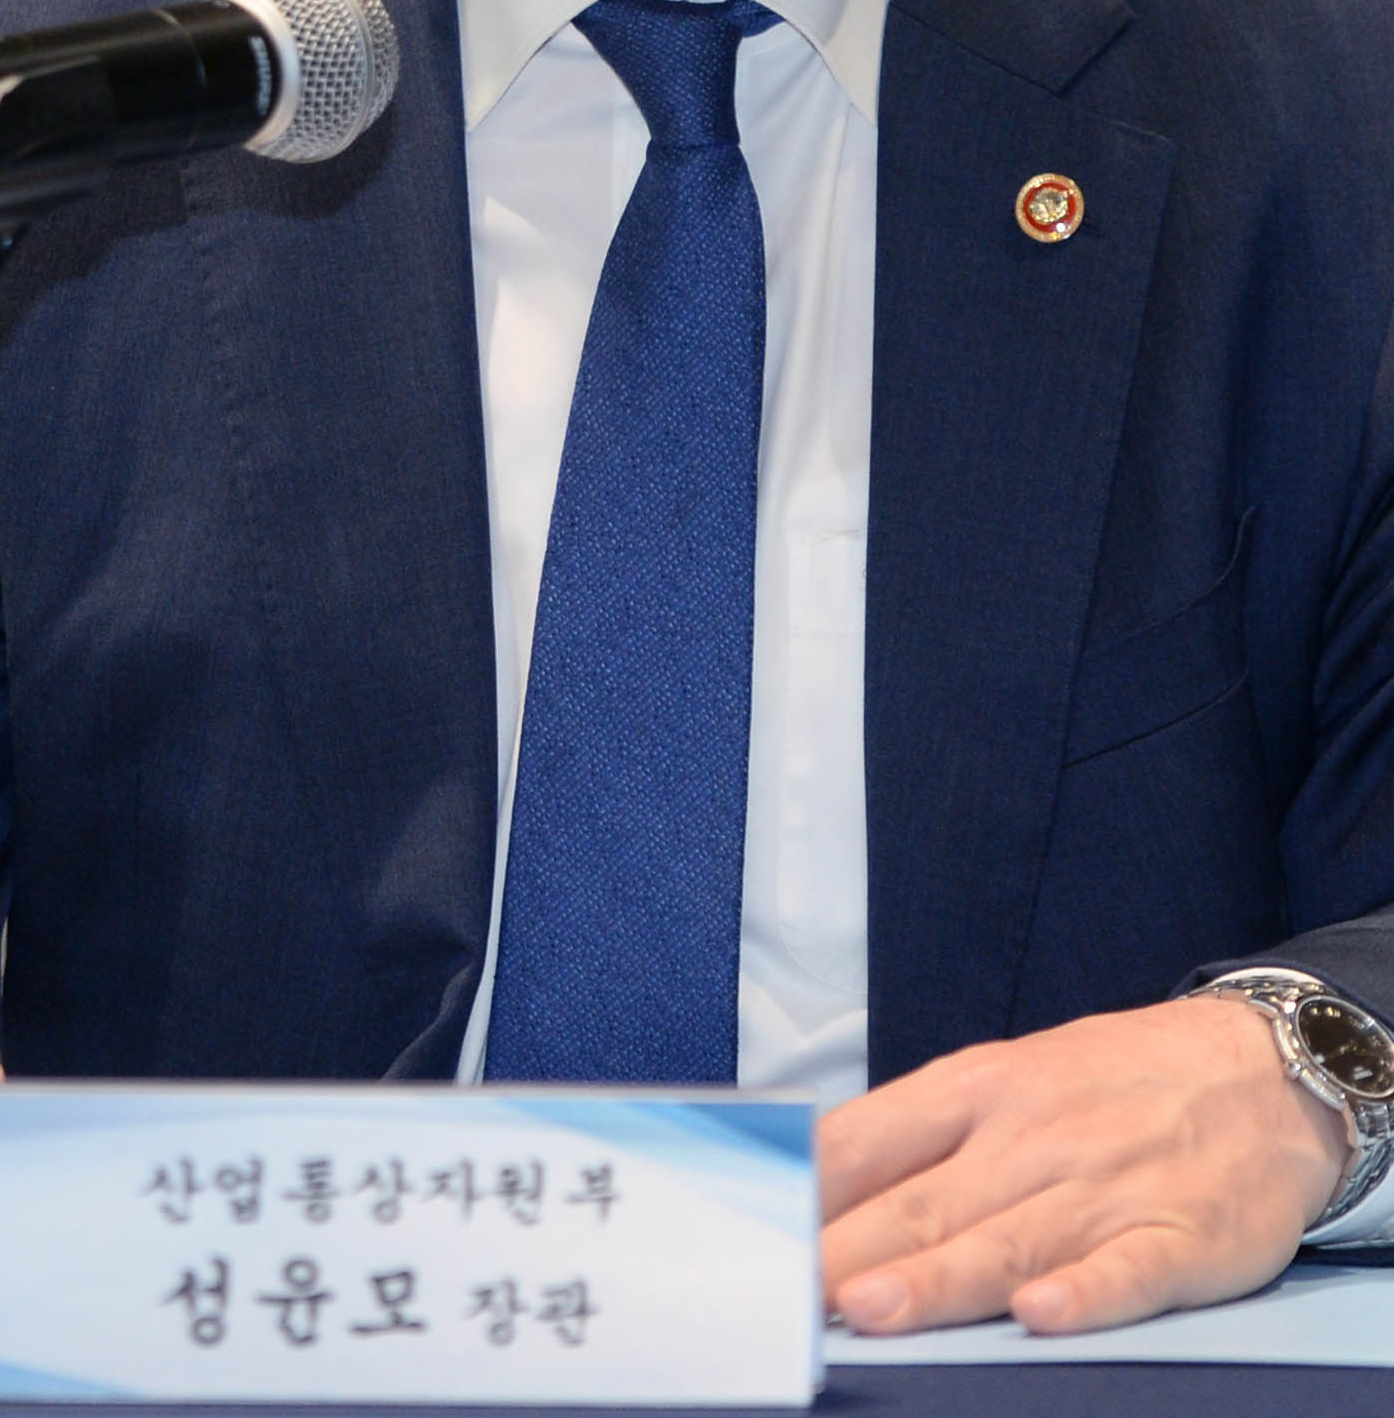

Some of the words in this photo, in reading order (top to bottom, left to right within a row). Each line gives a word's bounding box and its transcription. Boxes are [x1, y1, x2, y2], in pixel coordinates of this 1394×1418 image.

[141, 1154, 622, 1226] 산업통상자원부
[162, 1255, 430, 1347] 성윤모
[468, 1277, 600, 1347] 장관
